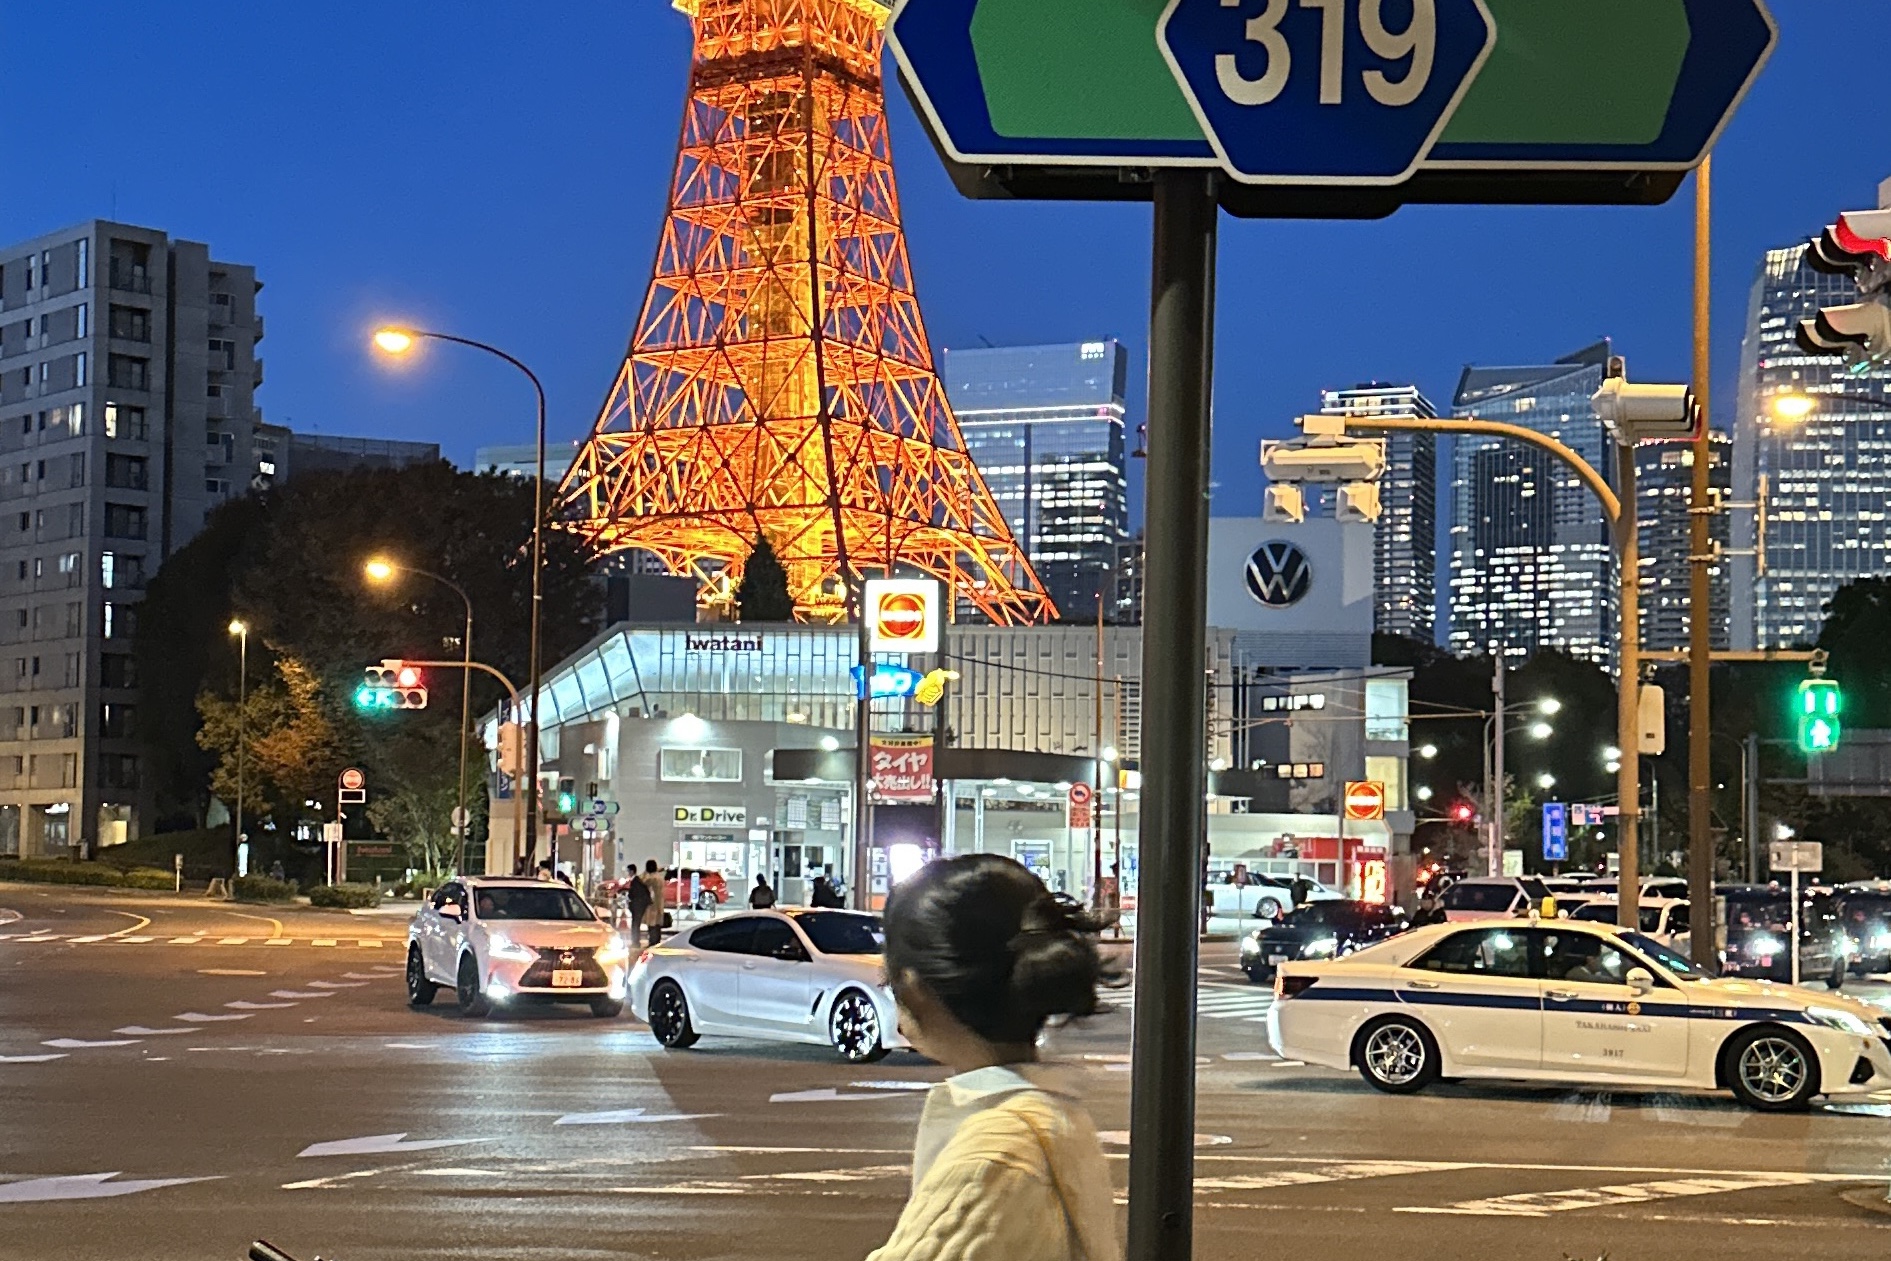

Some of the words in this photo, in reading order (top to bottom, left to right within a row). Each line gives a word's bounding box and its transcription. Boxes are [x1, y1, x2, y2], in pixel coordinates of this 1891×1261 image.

[1215, 0, 1437, 107] 319
[685, 635, 763, 651] Iwatani
[873, 751, 928, 772] タイヤ
